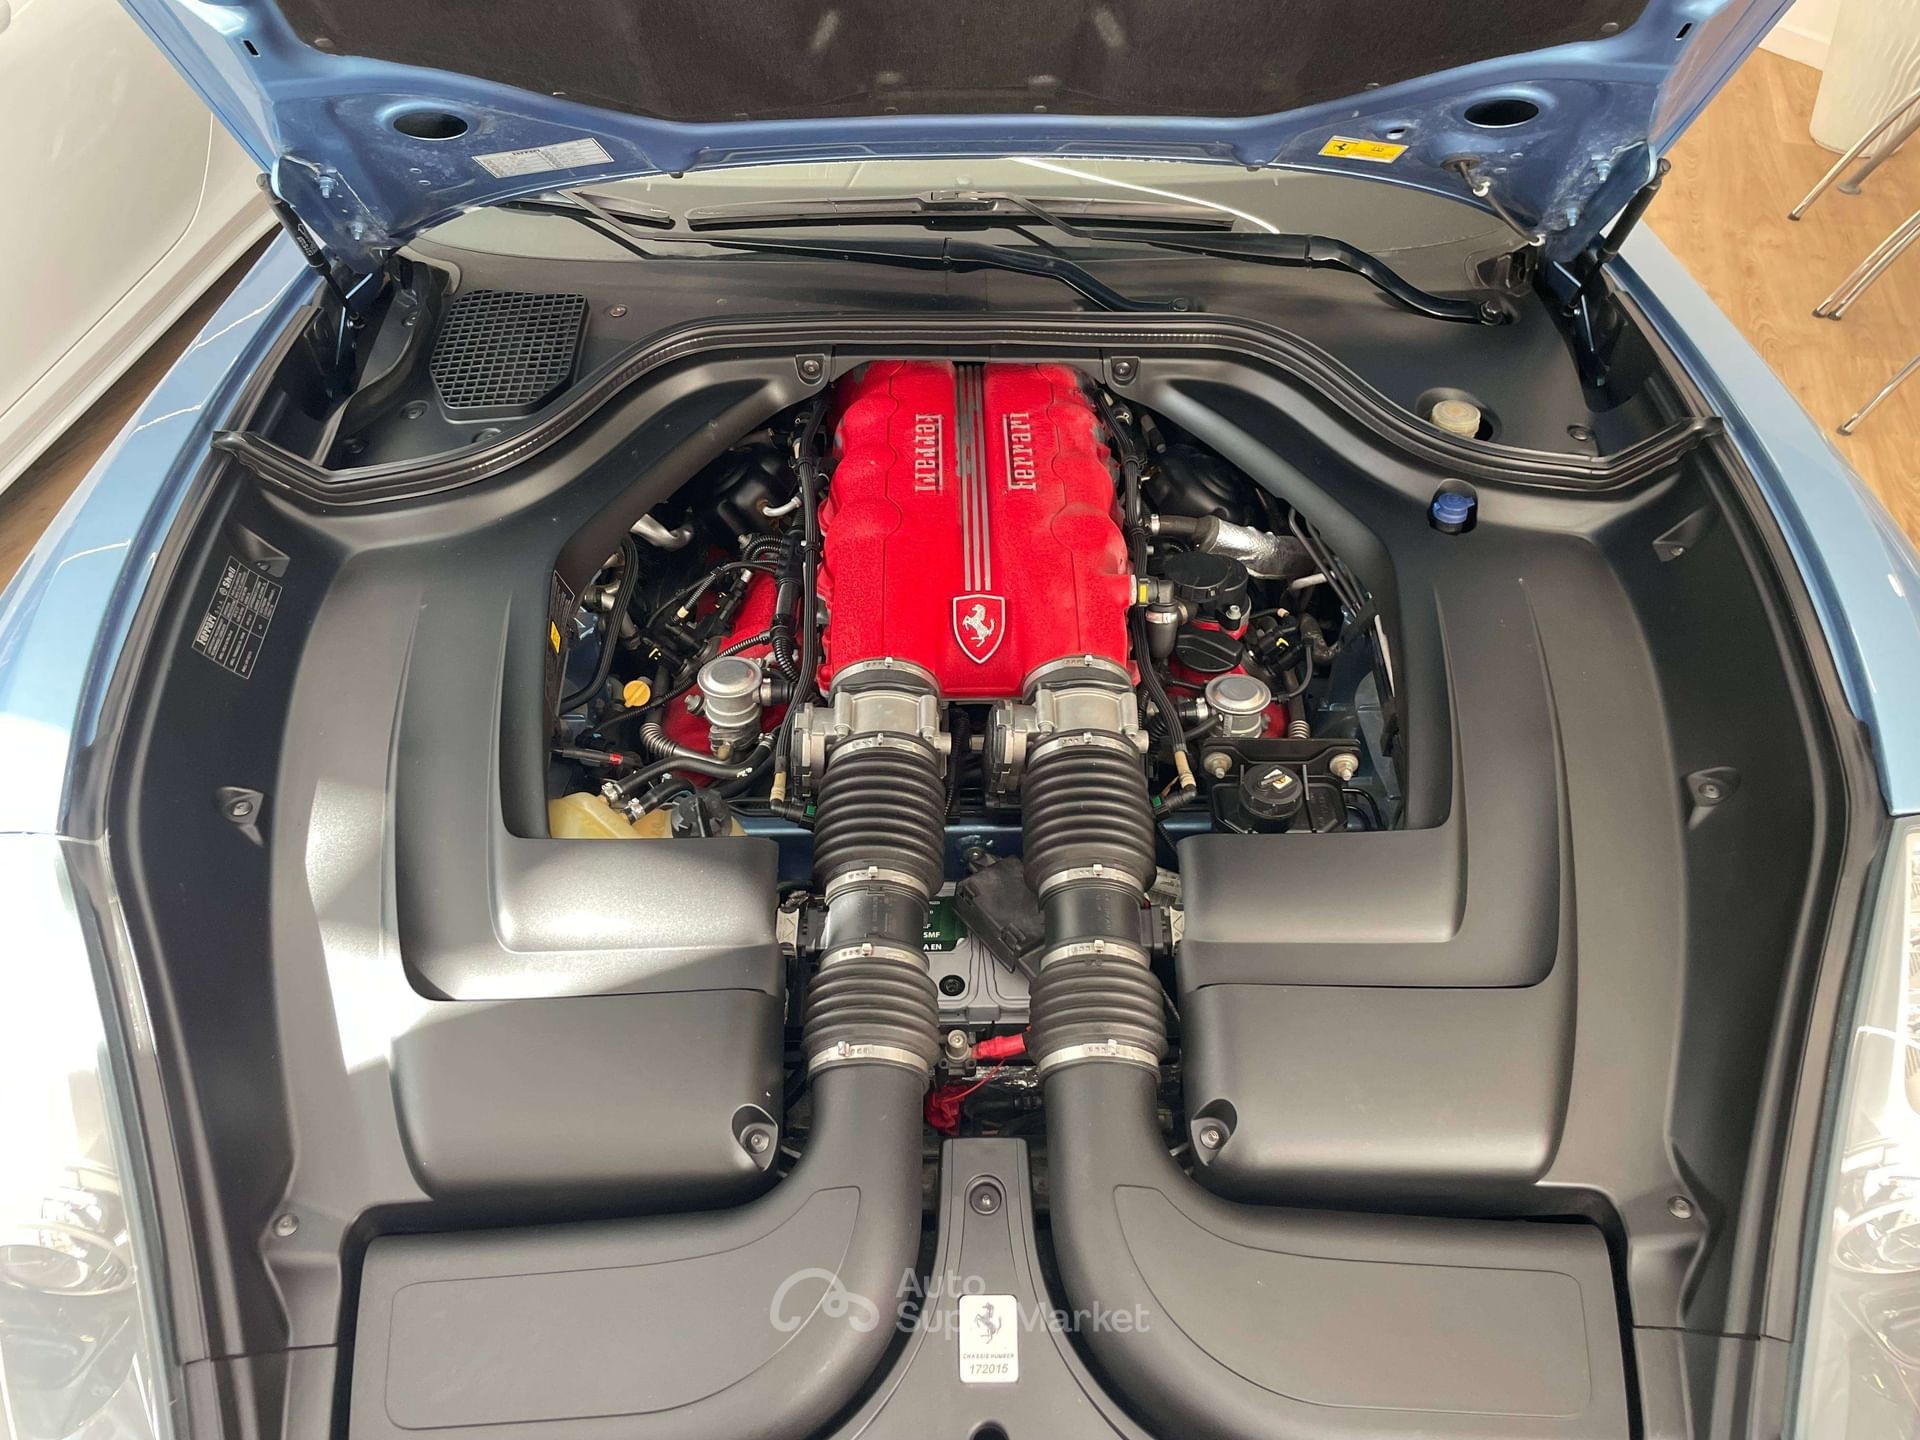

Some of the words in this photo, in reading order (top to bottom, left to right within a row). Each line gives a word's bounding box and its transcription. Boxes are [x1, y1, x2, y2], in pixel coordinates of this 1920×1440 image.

[915, 413, 943, 493] Ferrari
[1003, 412, 1037, 491] Ferrari
[197, 612, 217, 646] Ferrari
[222, 566, 236, 589] Shell
[970, 1363, 1009, 1375] 172015
